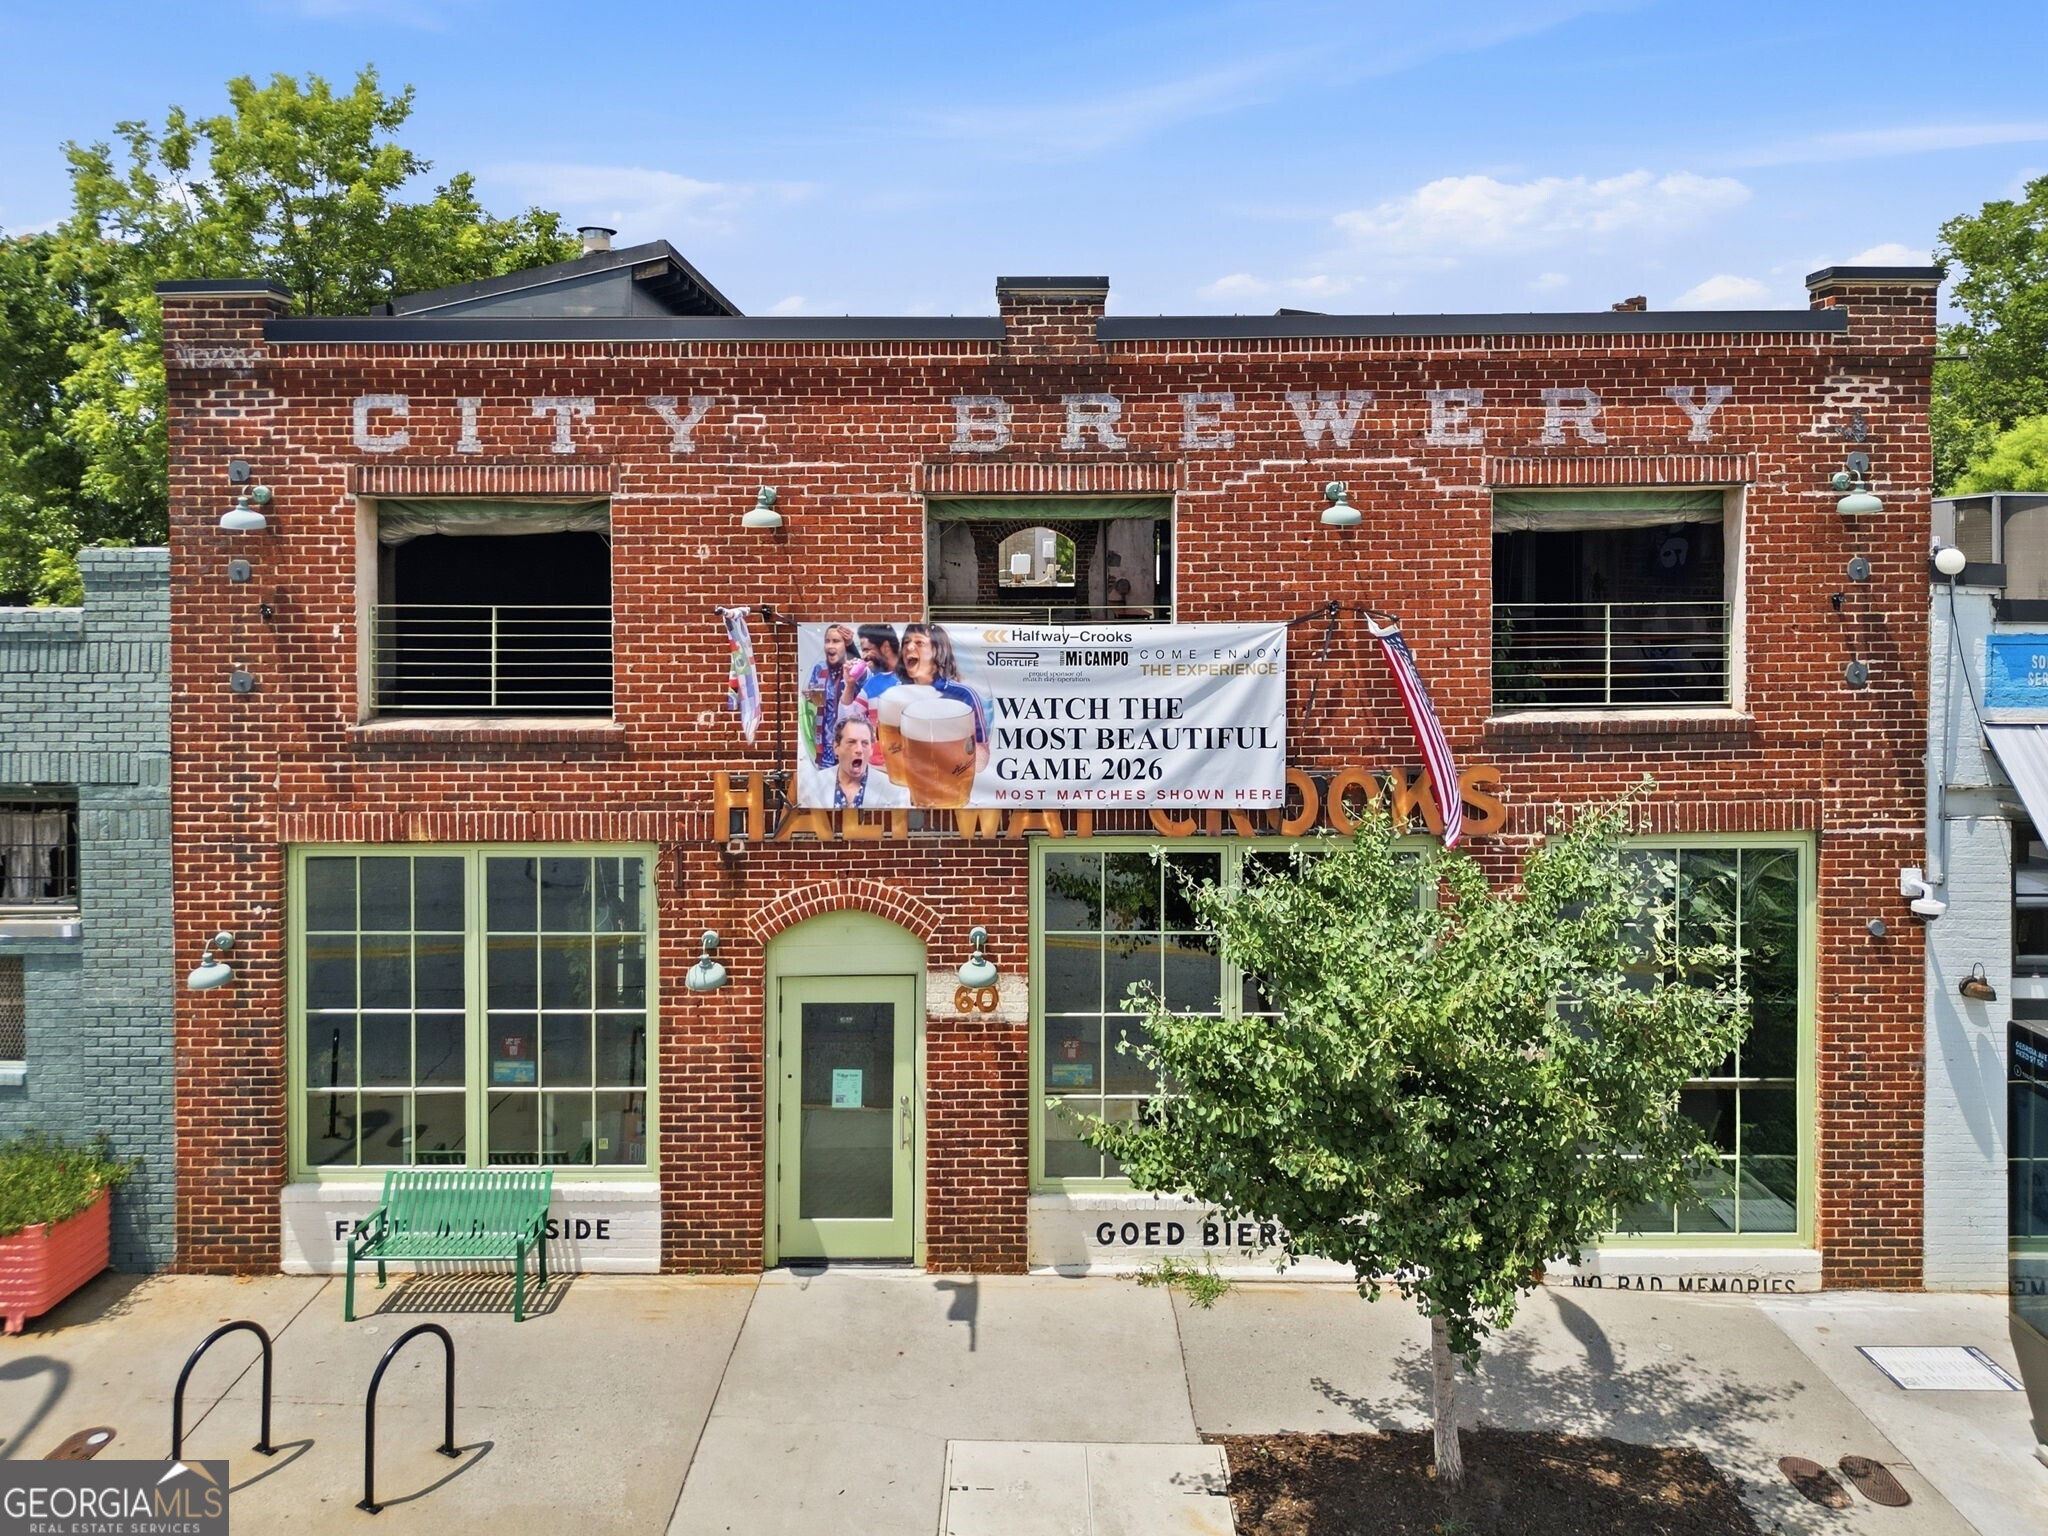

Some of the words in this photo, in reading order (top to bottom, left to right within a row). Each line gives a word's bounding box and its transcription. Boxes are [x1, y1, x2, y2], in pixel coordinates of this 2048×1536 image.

[352, 393, 715, 454] CITY
[950, 385, 1734, 454] BREWERY
[1085, 650, 1129, 667] CAMPO
[1139, 649, 1197, 660] COME
[1214, 648, 1281, 659] ENJOY
[1140, 664, 1172, 676] THE
[1176, 662, 1278, 676] EXPERIENCE
[995, 697, 1110, 720] WATCH
[1119, 697, 1184, 720] THE
[995, 727, 1088, 750] MOST
[1095, 726, 1279, 750] BEAUTIFUL
[995, 757, 1092, 781] GAME
[1101, 757, 1164, 781] 2026
[995, 789, 1047, 800] MOST
[1056, 789, 1147, 800] MATCHES
[1157, 788, 1224, 800] SHOWN
[1235, 788, 1284, 800] HERE
[954, 985, 1000, 1014] 60
[1096, 1221, 1185, 1246] GOED
[1572, 1275, 1601, 1288] NO
[1618, 1276, 1663, 1291] BAD
[1678, 1277, 1797, 1293] MEMORIES
